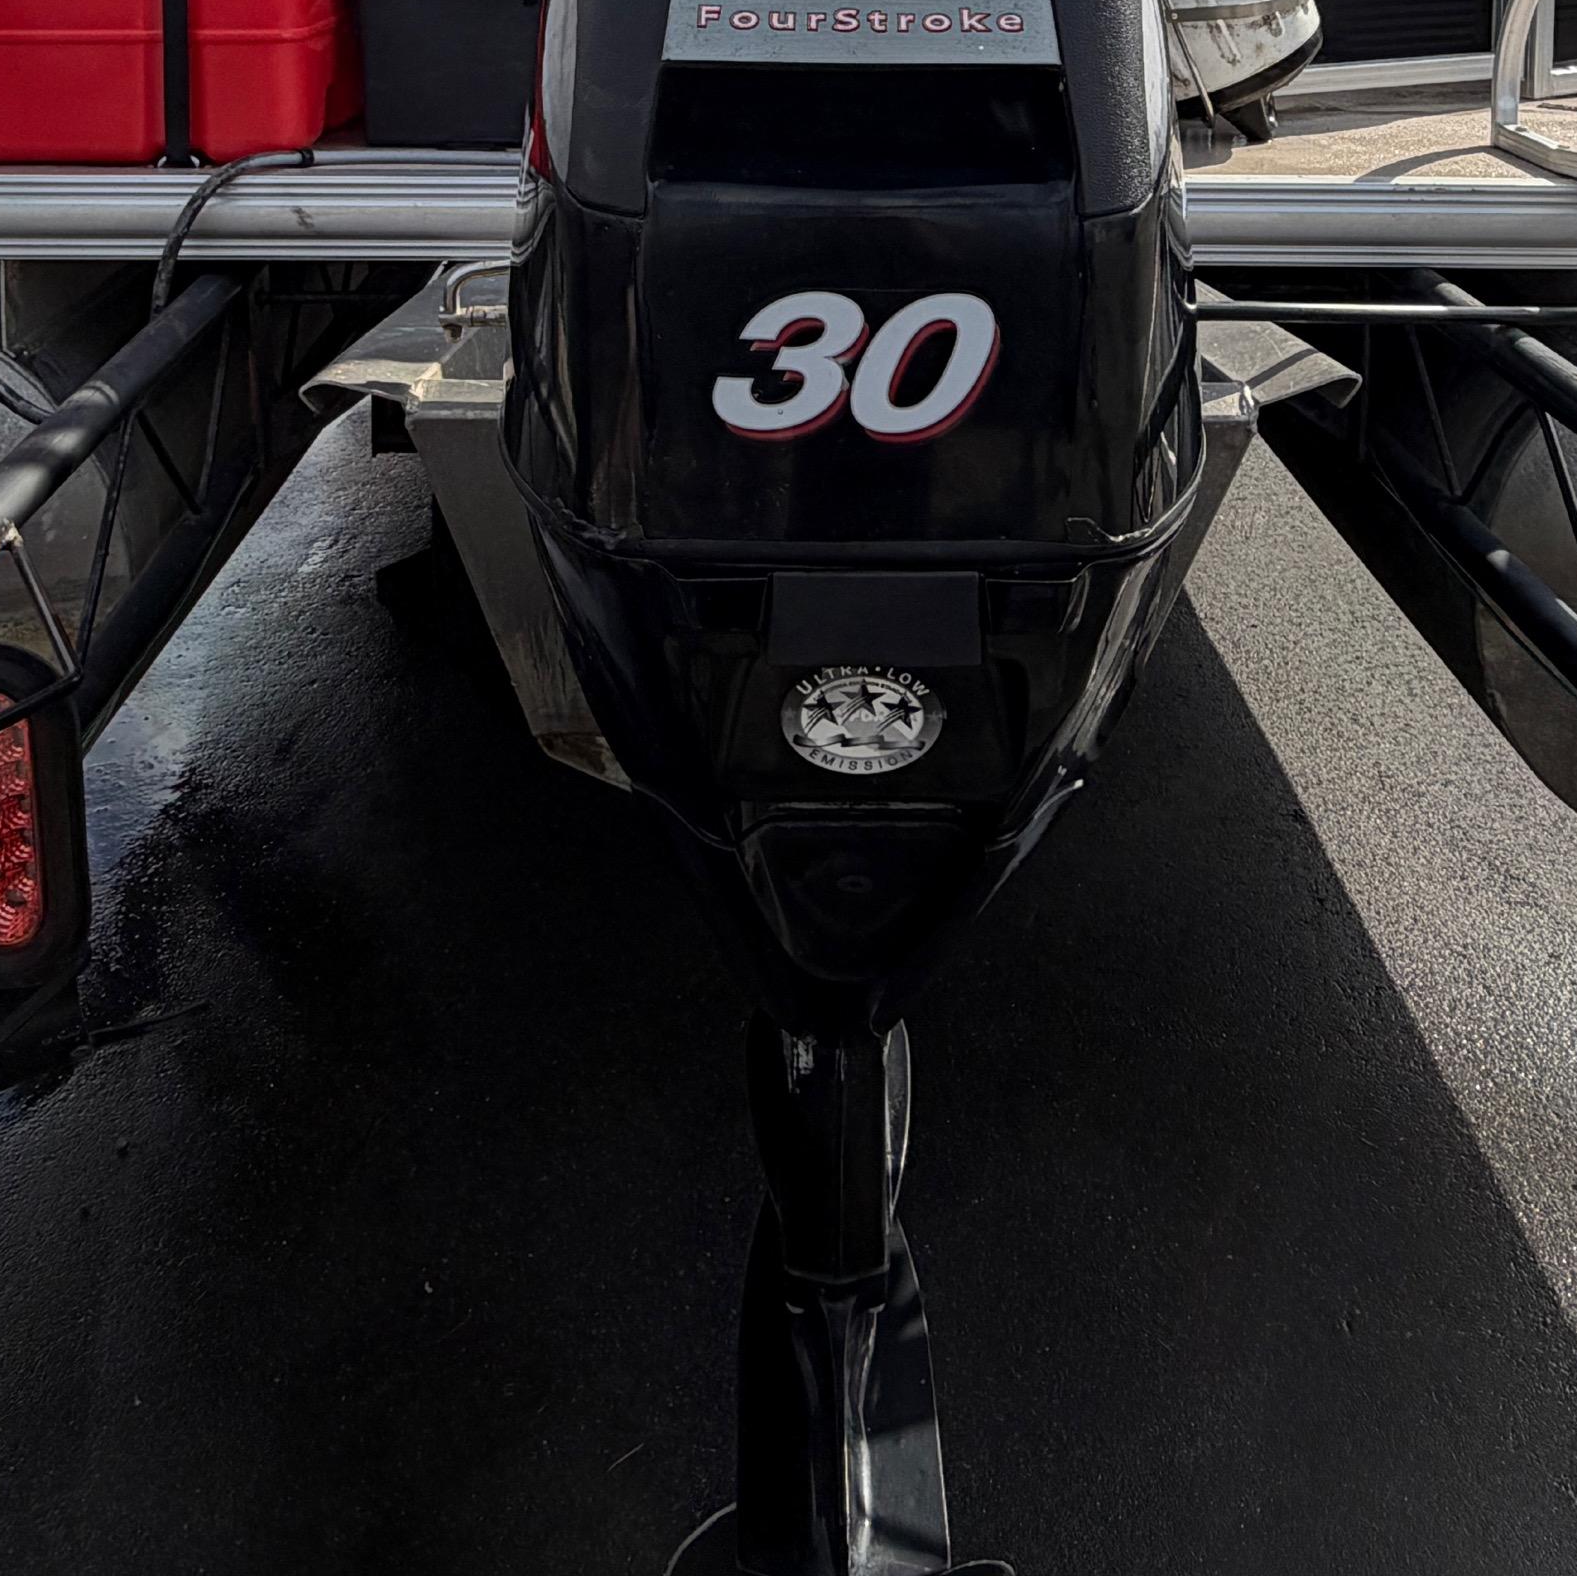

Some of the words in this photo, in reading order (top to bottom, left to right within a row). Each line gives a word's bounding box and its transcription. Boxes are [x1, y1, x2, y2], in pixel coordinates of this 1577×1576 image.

[696, 4, 1025, 33] FourStroke
[712, 291, 1000, 442] 30
[887, 667, 930, 696] LOW
[809, 748, 913, 771] EMISSION
